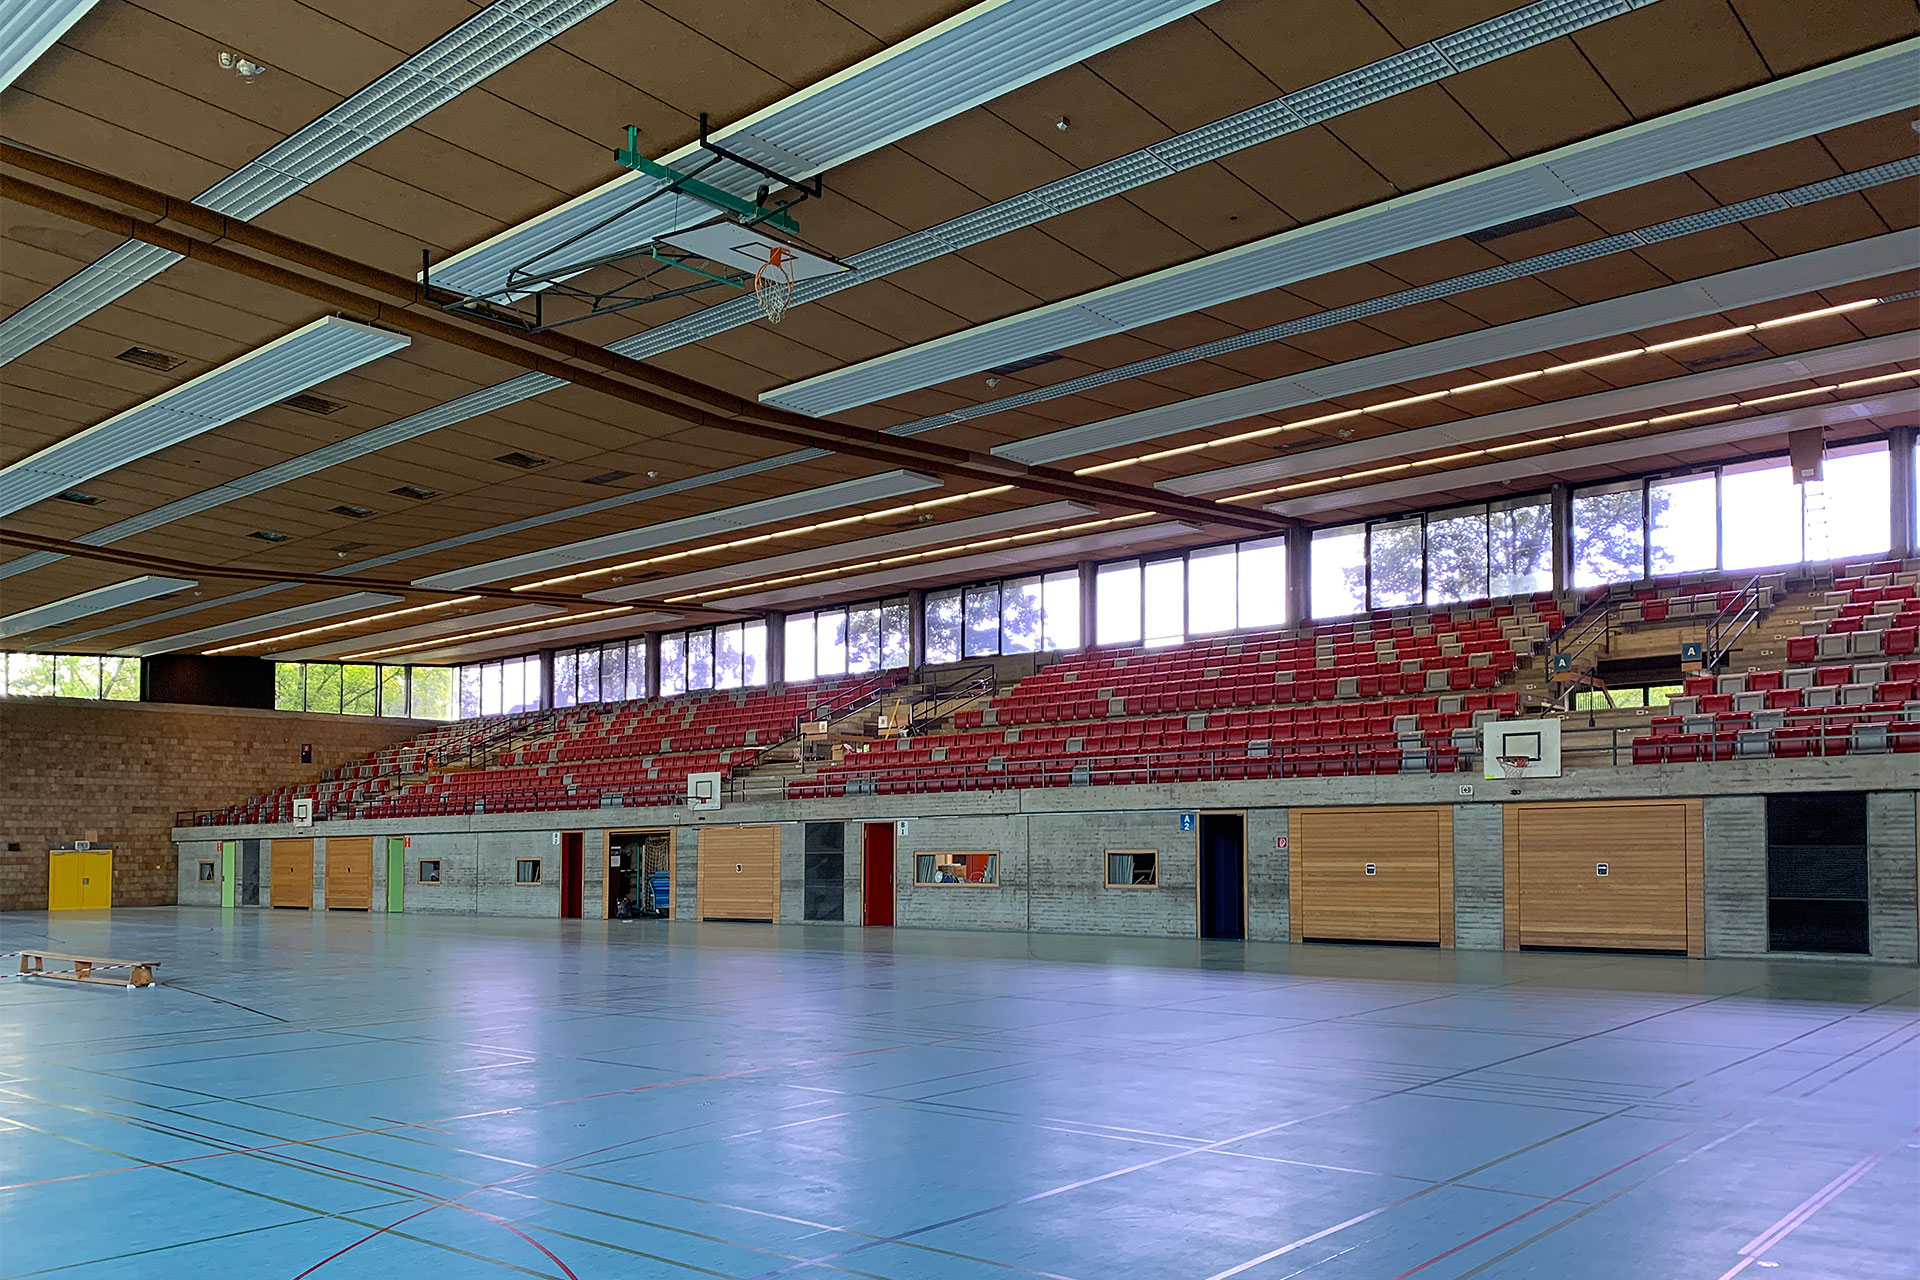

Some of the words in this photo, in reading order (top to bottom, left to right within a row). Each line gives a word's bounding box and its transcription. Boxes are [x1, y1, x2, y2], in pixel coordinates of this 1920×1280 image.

[1687, 647, 1696, 656] A
[1558, 659, 1567, 667] A
[1184, 815, 1191, 823] A
